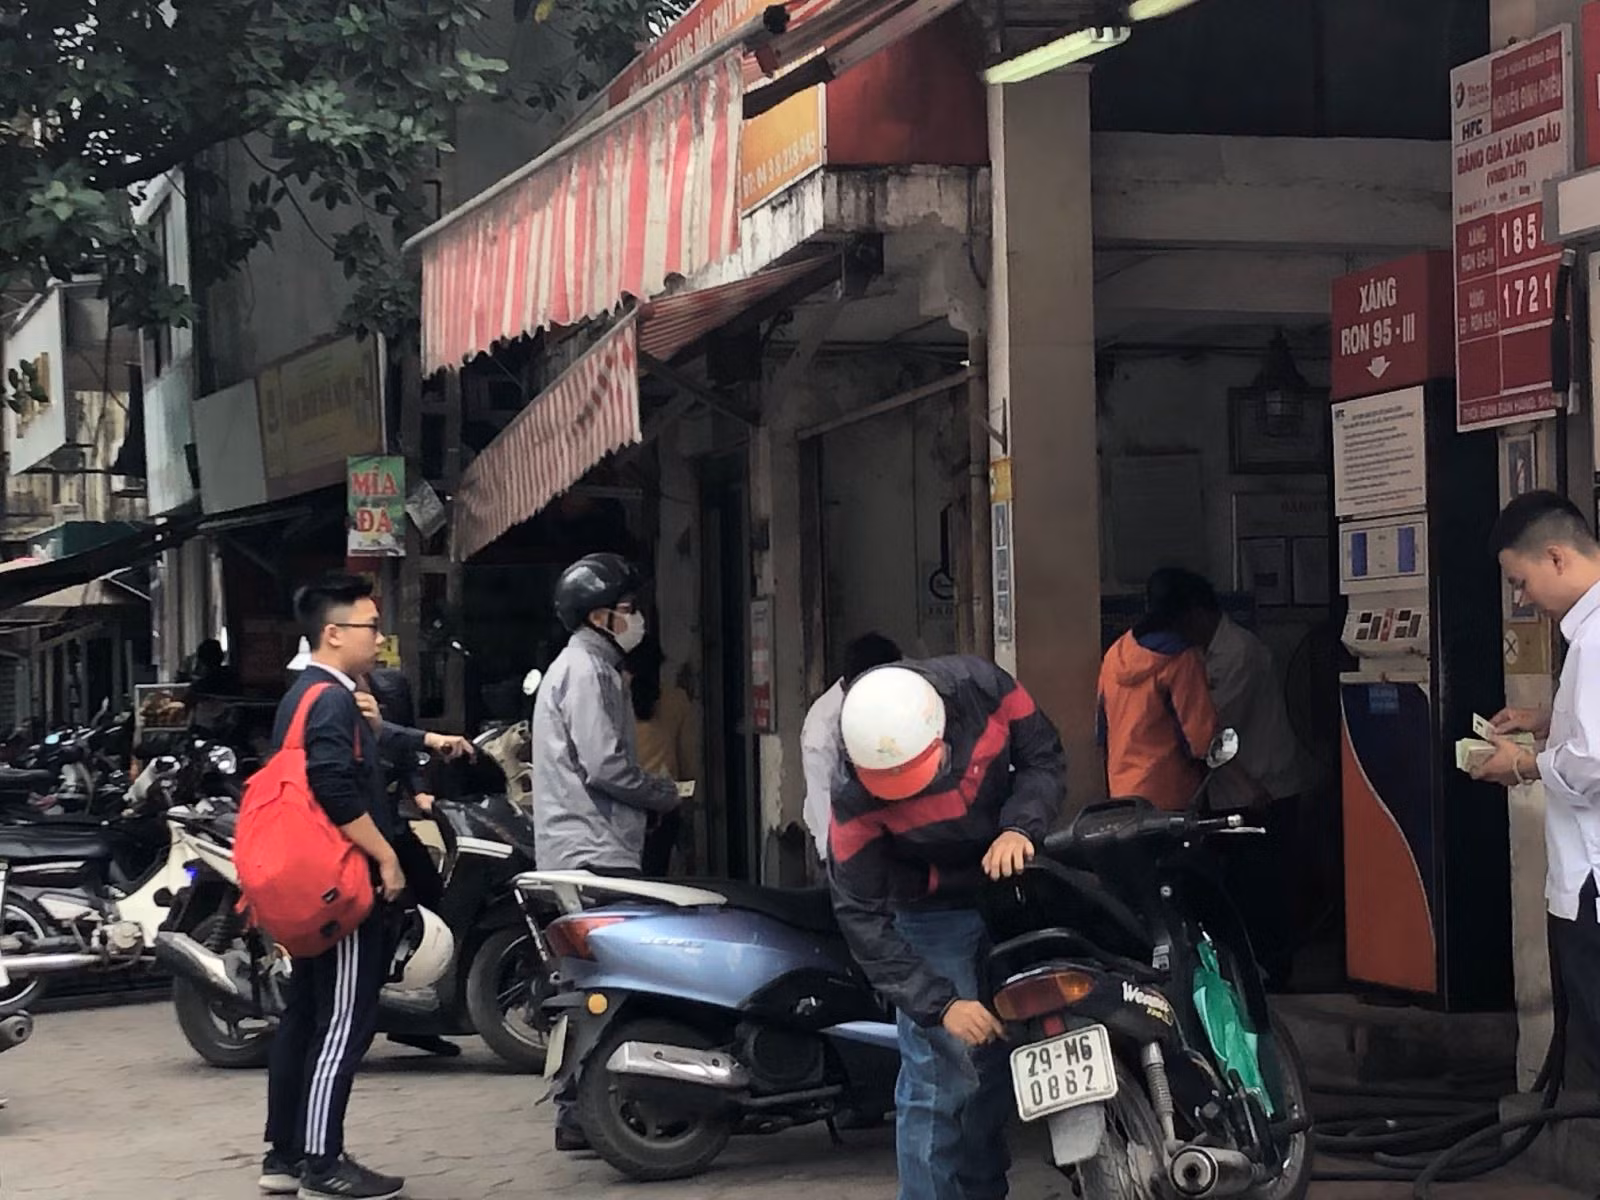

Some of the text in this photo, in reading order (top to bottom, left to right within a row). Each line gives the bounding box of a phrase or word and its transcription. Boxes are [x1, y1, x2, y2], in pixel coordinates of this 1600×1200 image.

[1486, 137, 1503, 165] GIÁ
[1359, 276, 1397, 314] XĂNG
[1341, 322, 1370, 356] RON
[1025, 1034, 1094, 1078] 29-M6
[1029, 1064, 1098, 1106] 0882
